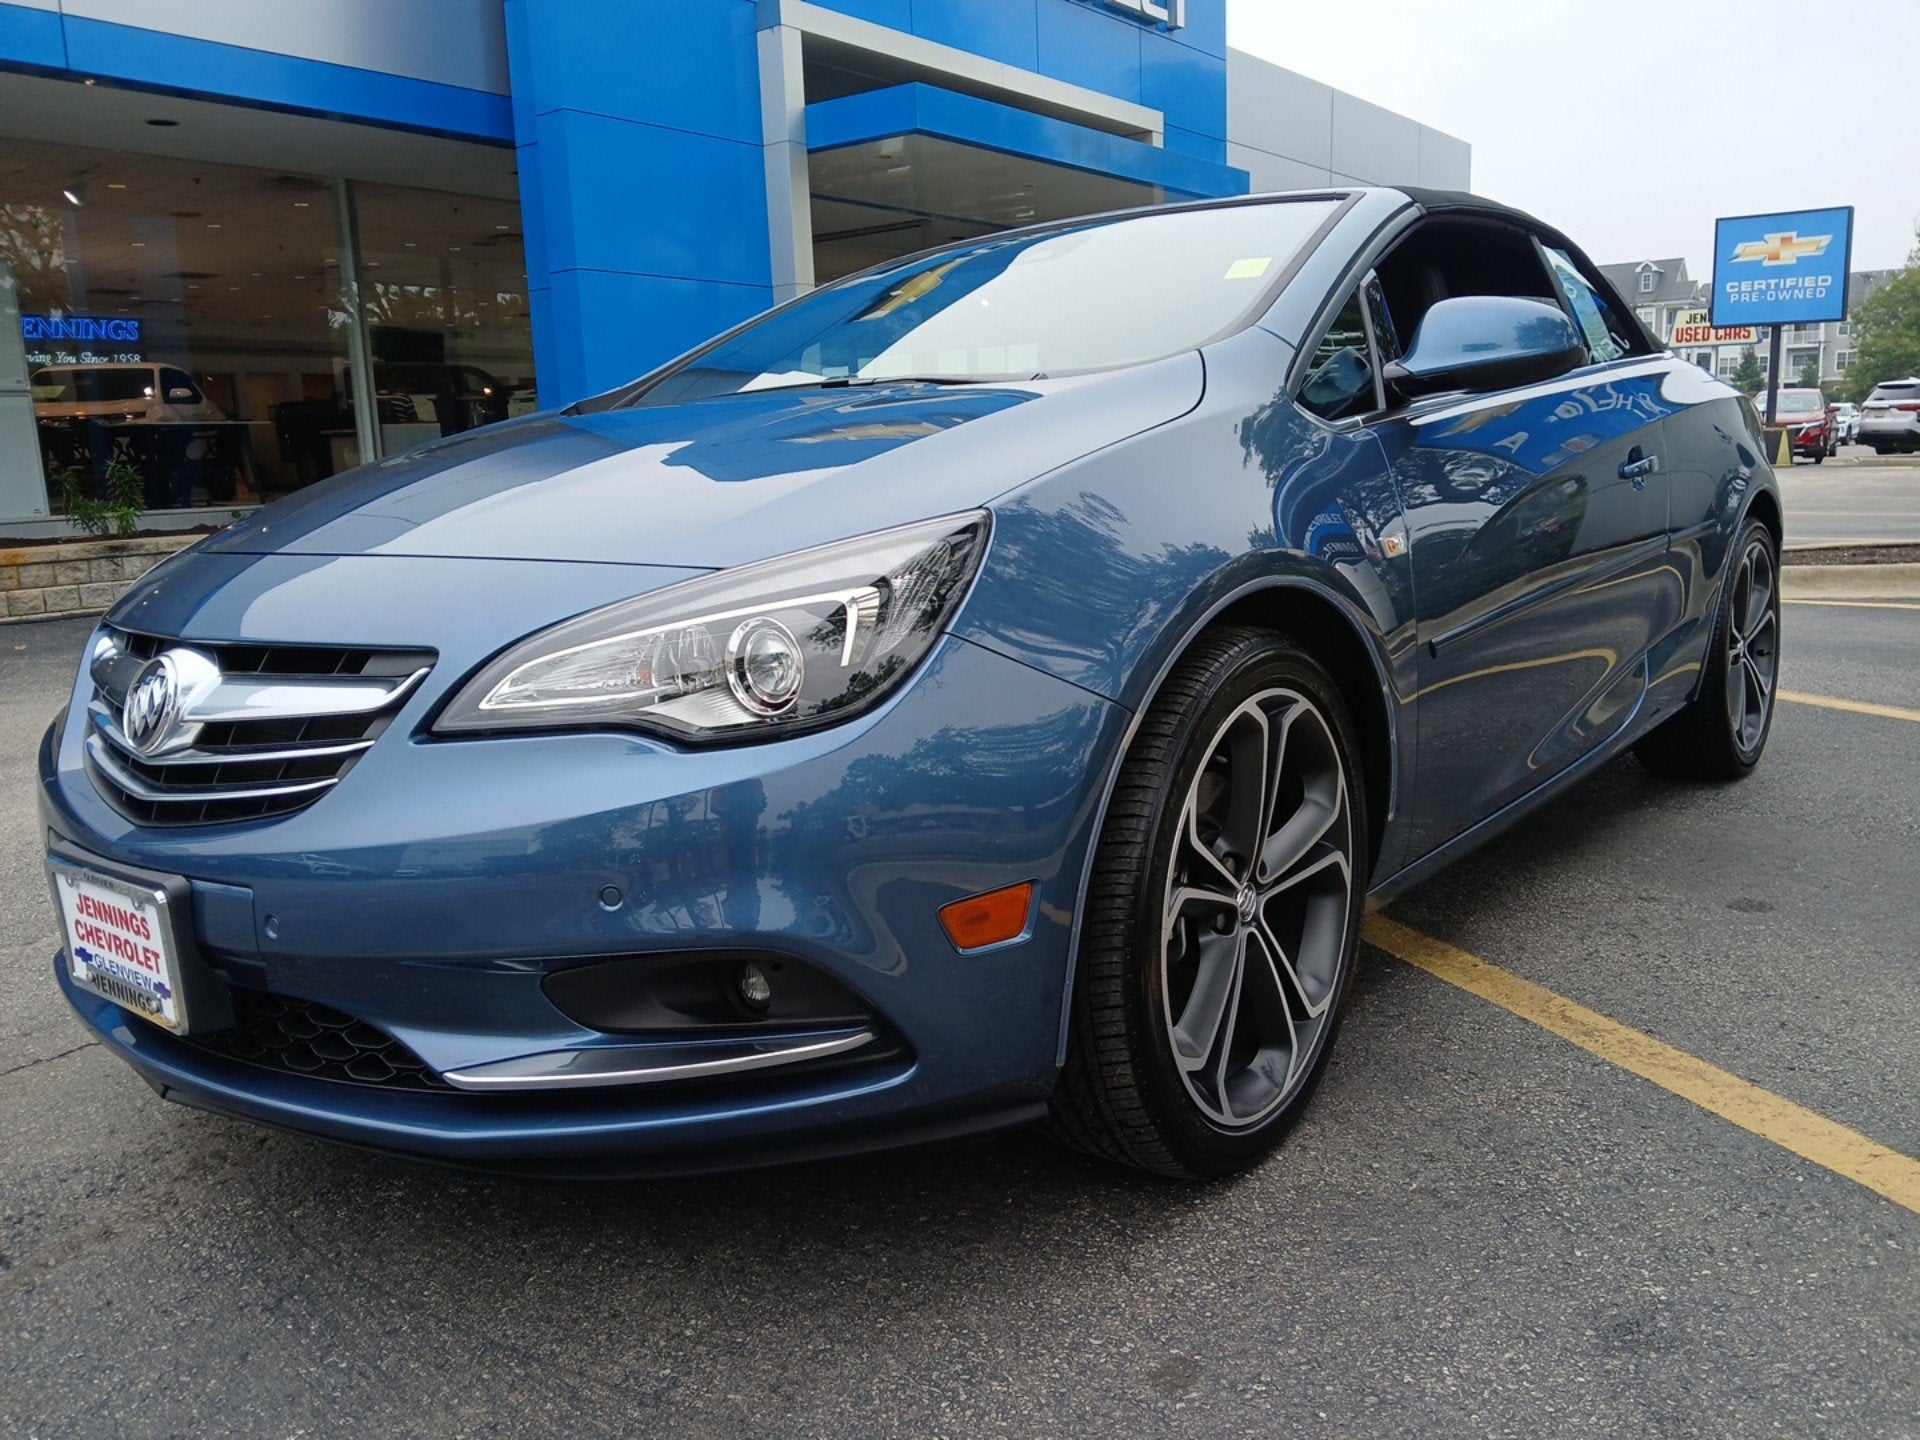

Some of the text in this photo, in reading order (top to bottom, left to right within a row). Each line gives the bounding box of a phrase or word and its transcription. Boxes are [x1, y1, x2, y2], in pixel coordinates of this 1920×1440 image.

[1726, 275, 1832, 293] CERTIFIED
[1730, 287, 1826, 303] PRE-OWNED
[20, 317, 139, 340] ENNINGS
[1676, 326, 1751, 343] USED CARS
[55, 352, 76, 363] You
[76, 893, 151, 941] JENNINGS
[74, 919, 160, 974] CHEVROLET
[94, 954, 152, 991] GLENVIEW
